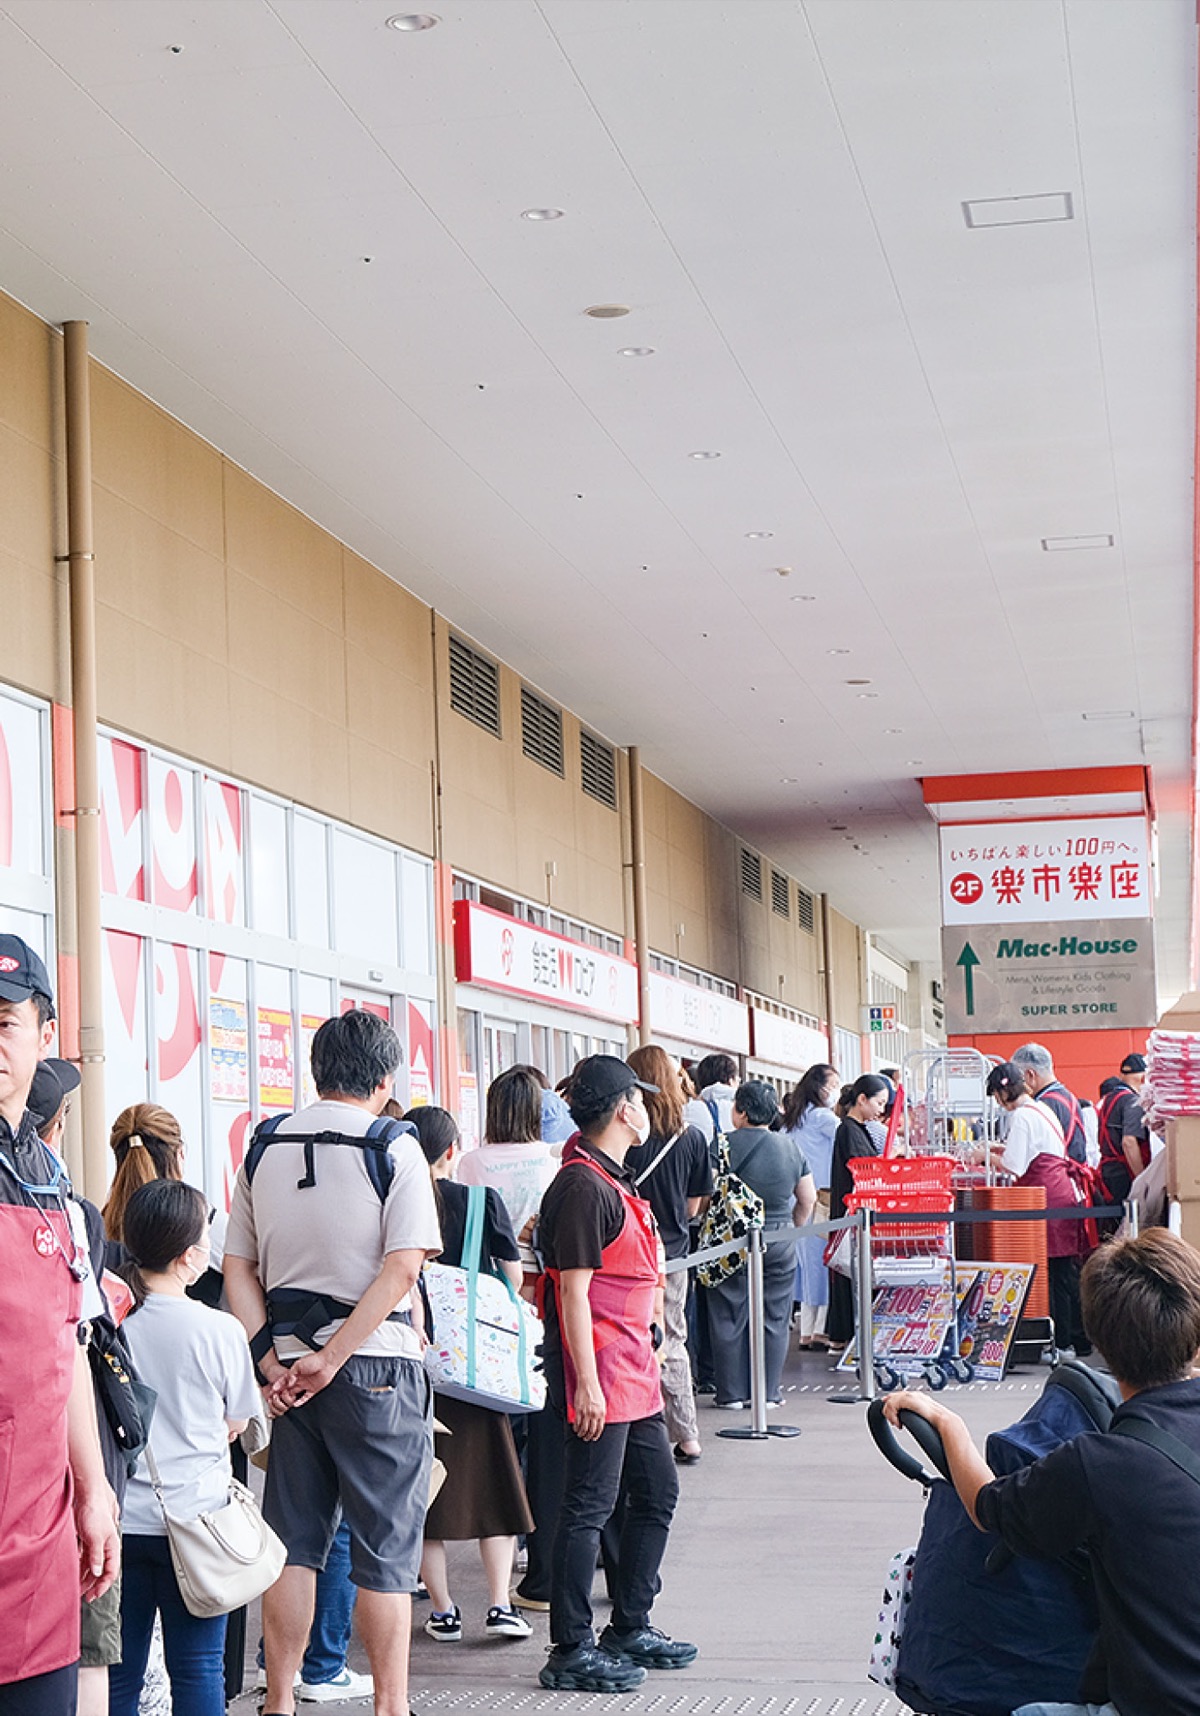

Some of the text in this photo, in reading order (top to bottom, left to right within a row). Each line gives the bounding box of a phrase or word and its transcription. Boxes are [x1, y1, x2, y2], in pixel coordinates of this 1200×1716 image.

[951, 837, 1138, 861] いちばん楽しい100円へ。
[1021, 1002, 1118, 1016] SUPER STORE
